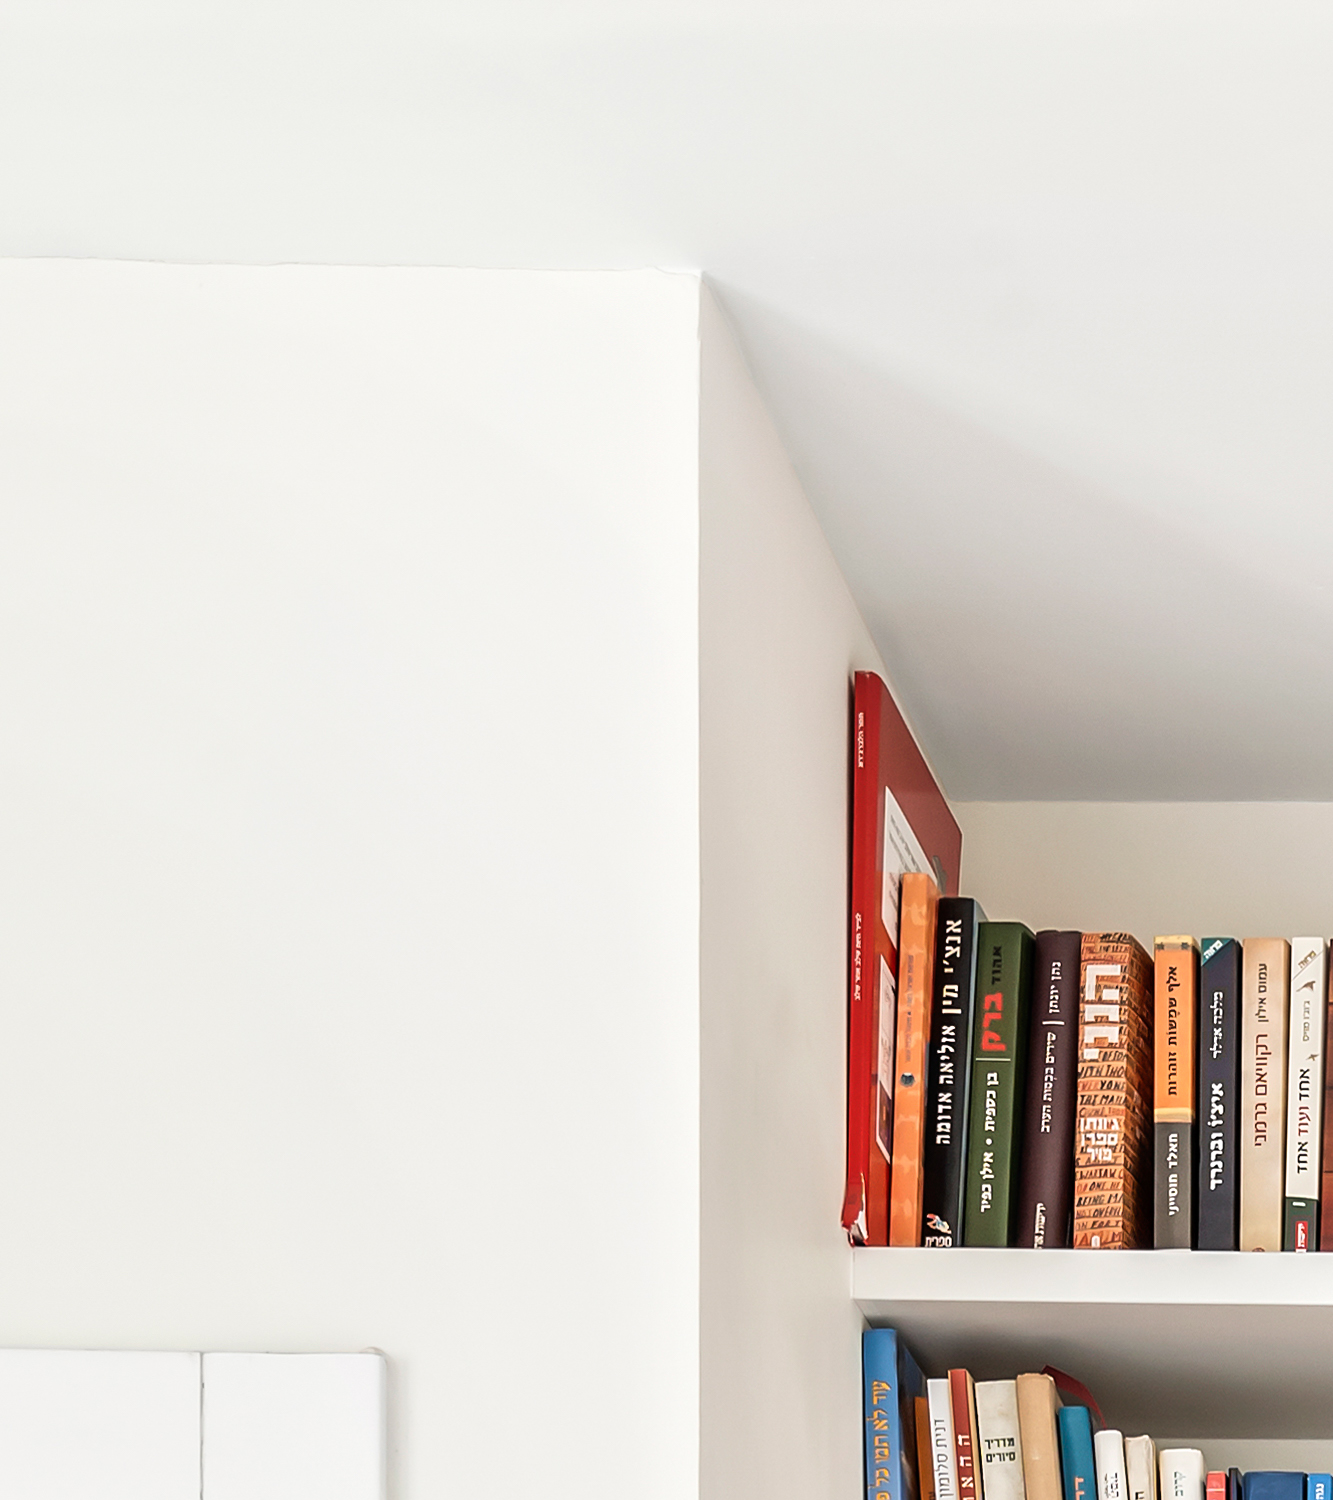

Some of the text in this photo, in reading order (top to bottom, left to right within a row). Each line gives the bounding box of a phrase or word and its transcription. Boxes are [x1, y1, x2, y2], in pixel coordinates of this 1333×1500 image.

[982, 946, 1005, 1051] אהוד ברק
[936, 920, 961, 1144] אנצ'י מין אזליאה אדומה
[1255, 964, 1271, 1146] עמוס אילון רקוויאם גרמני
[980, 1073, 998, 1212] בן כספית אילן כפיר
[1081, 1133, 1118, 1146] ספרן
[1087, 1148, 1112, 1163] פויר
[985, 1437, 1014, 1449] מדריך
[986, 1452, 1015, 1462] סיורים
